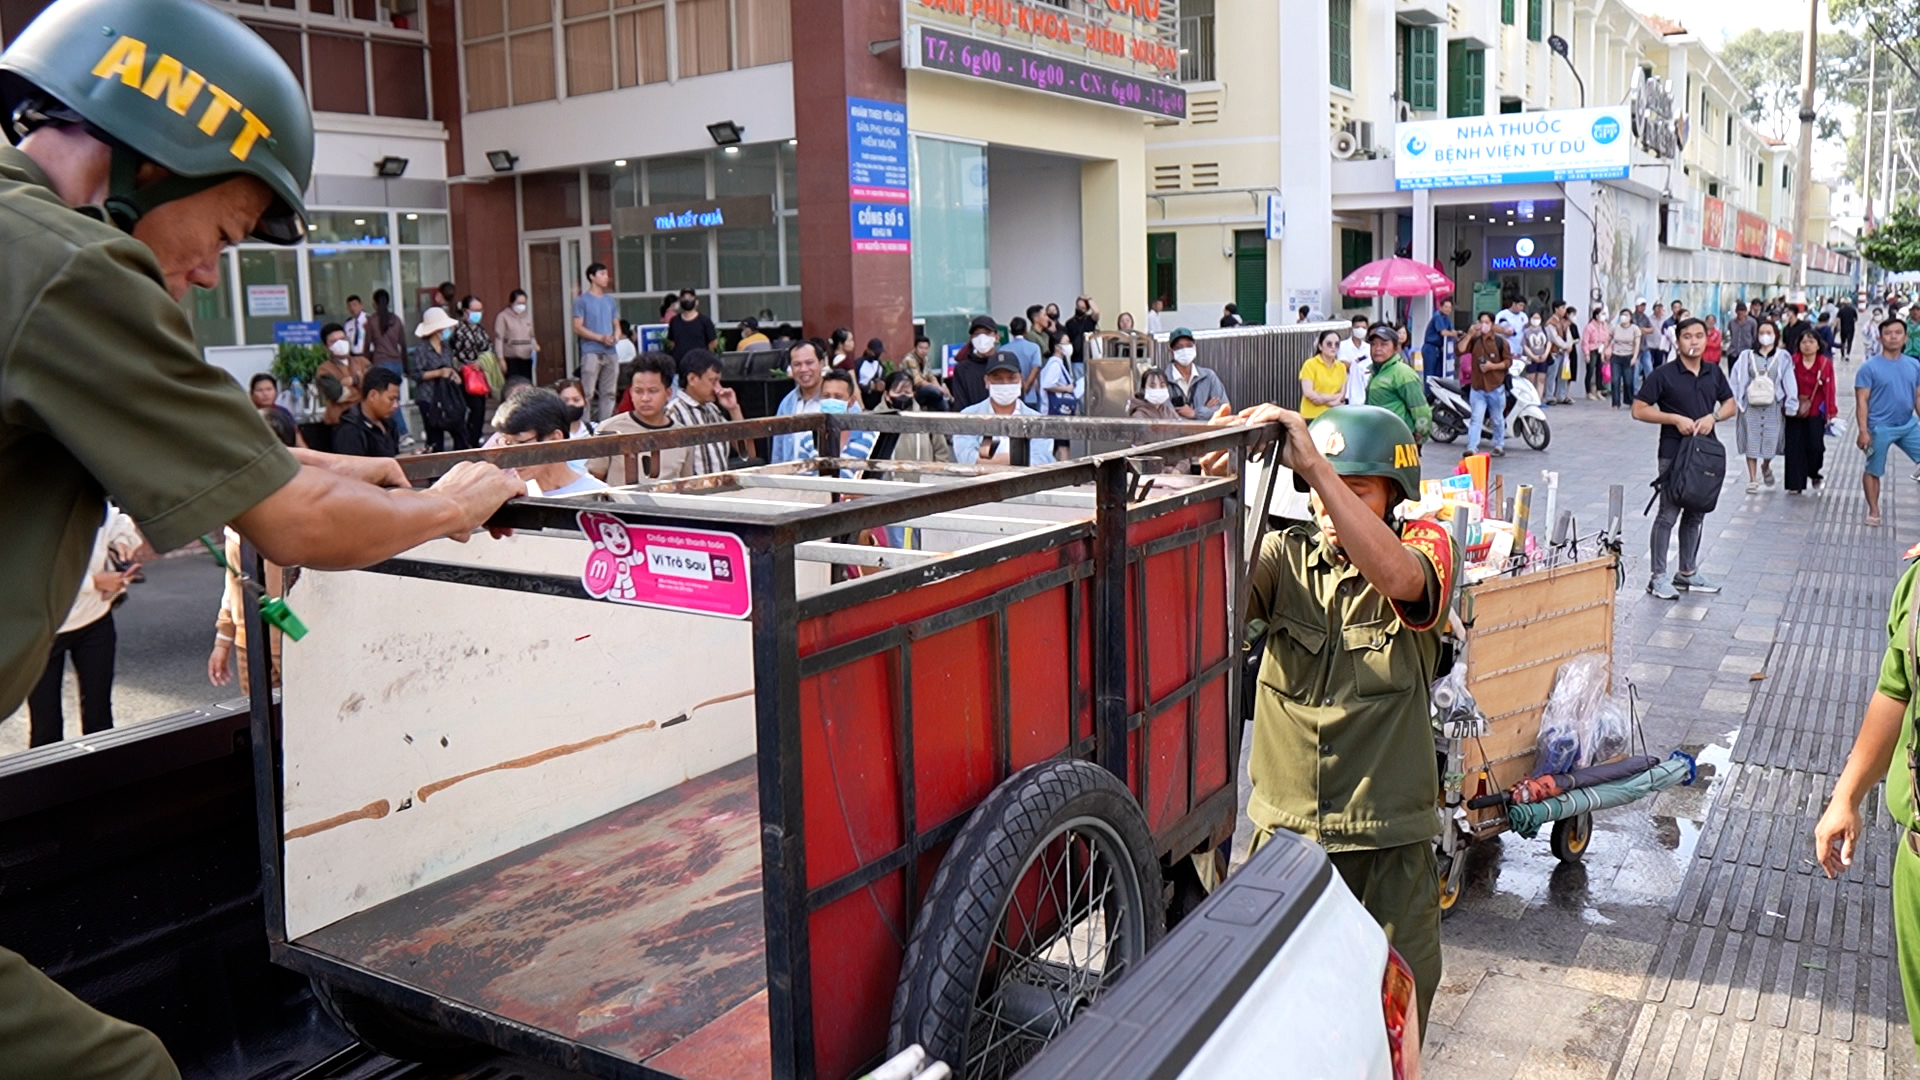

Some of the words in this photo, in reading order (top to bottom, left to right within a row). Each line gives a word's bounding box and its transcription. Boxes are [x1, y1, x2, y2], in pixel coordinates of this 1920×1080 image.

[1018, 11, 1071, 43] KHOA
[925, 36, 954, 63] T7:
[961, 45, 1001, 76] 6g00
[1021, 58, 1064, 89] 16g00
[1080, 72, 1107, 95] CN:
[1111, 79, 1142, 105] 6g00
[91, 35, 272, 162] ANTT
[1457, 122, 1494, 139] NHÀ
[1499, 114, 1562, 138] THUỐC
[1594, 127, 1618, 139] GPP
[1435, 142, 1480, 162] BỆNH
[1486, 140, 1525, 159] VIỆN
[1531, 137, 1556, 156] TỪ
[1560, 136, 1585, 154] DŨ
[655, 211, 676, 229] TRẢ
[677, 210, 698, 228] KẾT
[699, 207, 724, 226] QUẢ
[858, 205, 883, 226] CỔNG
[884, 208, 896, 227] SỐ
[897, 212, 904, 227] 5
[1492, 254, 1516, 268] NHÀ
[1519, 253, 1557, 268] THUỐC
[646, 533, 666, 544] Chấp
[667, 535, 684, 546] nhận
[685, 537, 707, 547] thanh
[707, 540, 725, 549] toán
[667, 555, 682, 568] Trả
[685, 558, 706, 571] Sau
